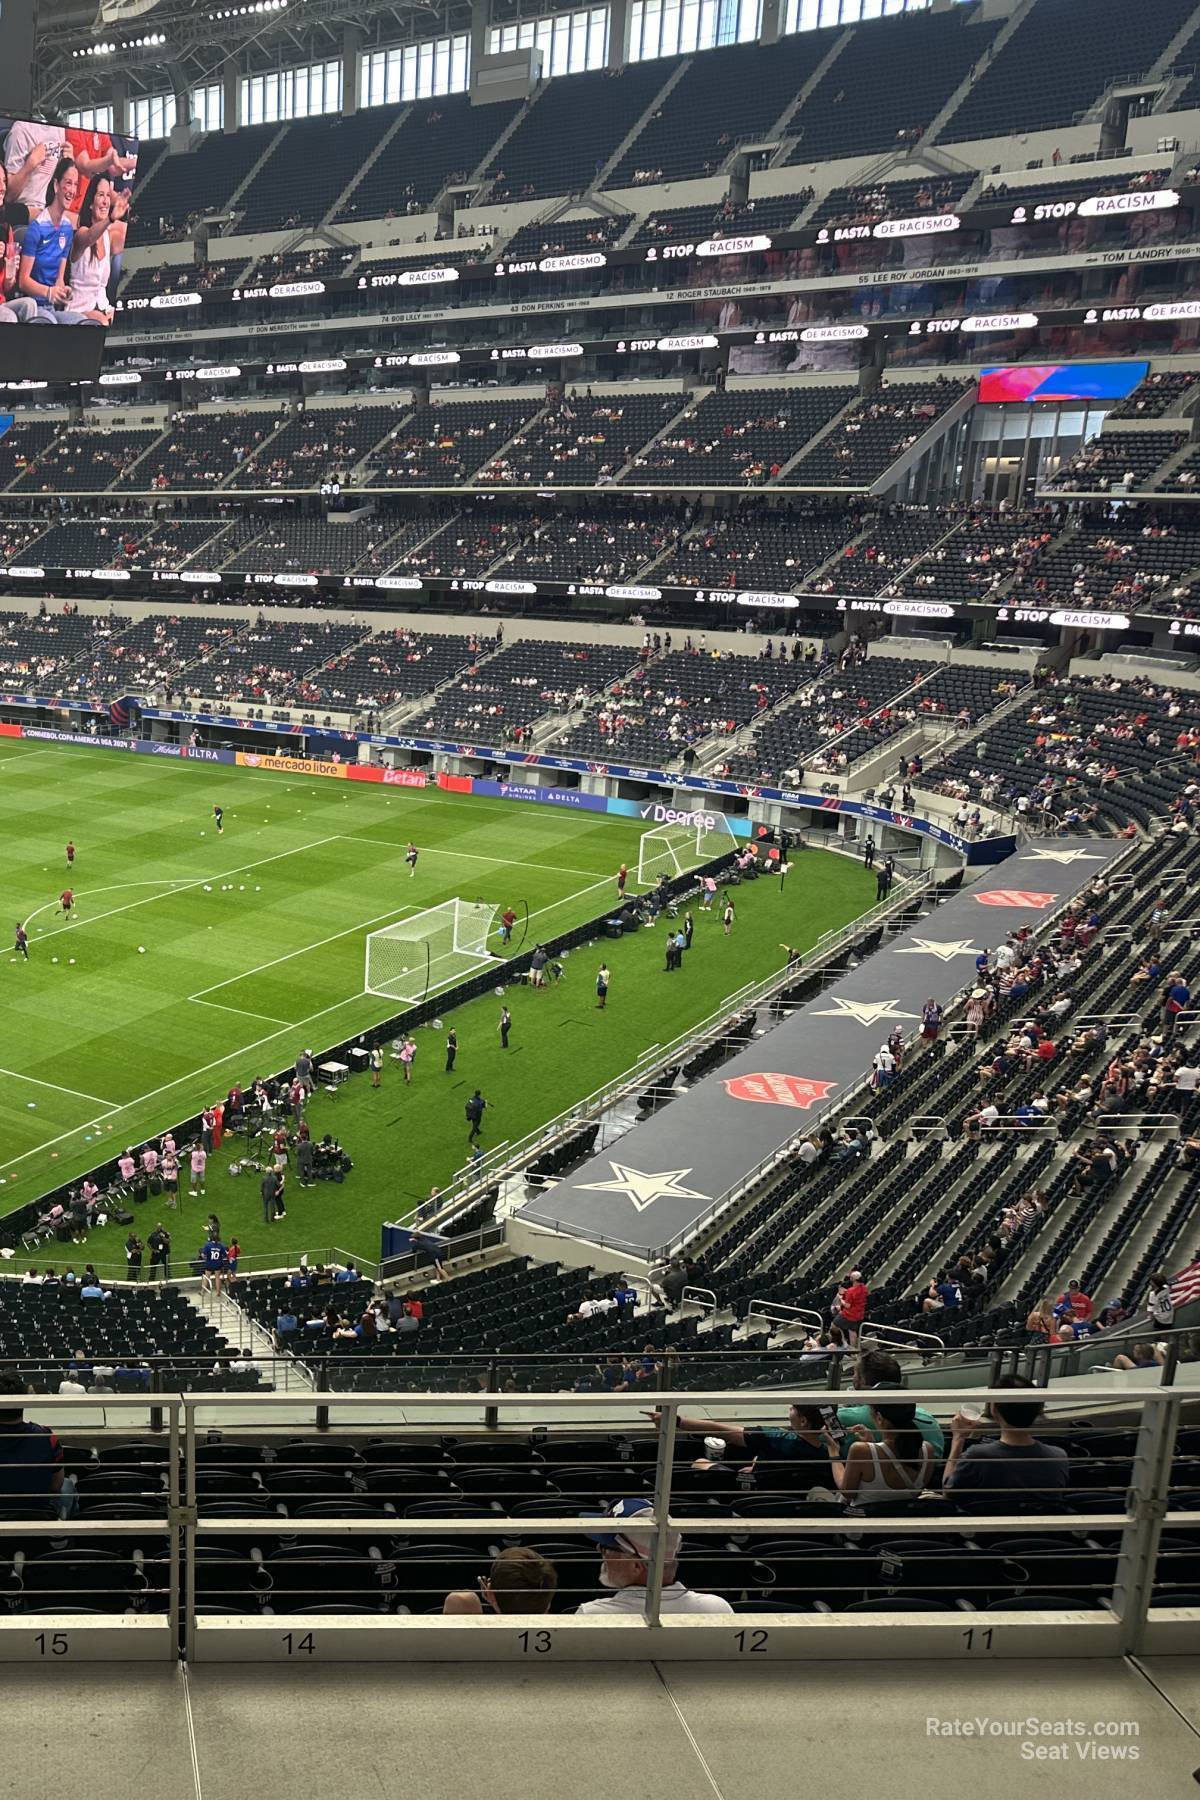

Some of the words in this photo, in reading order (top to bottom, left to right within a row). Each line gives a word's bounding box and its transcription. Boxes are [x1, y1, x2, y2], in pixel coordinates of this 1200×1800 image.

[1033, 202, 1075, 220] STOP
[1096, 195, 1155, 212] RACISM
[835, 225, 870, 240] BASTA
[881, 224, 895, 233] DE
[899, 217, 952, 232] RACISMO
[663, 244, 693, 258] STOP
[709, 239, 754, 252] RACISM
[1102, 252, 1125, 262] TOM
[1128, 248, 1172, 260] LANDRY
[509, 262, 537, 273] BASTA
[545, 259, 557, 269] DE
[559, 255, 601, 267] RACISMO
[371, 275, 397, 286] STOP
[409, 271, 445, 282] RACISM
[873, 274, 888, 283] LEE
[890, 272, 907, 281] ROY
[909, 269, 945, 280] JORDAN
[244, 288, 268, 298] BASTA
[286, 284, 321, 293] RACISMO
[677, 291, 702, 299] ROGER
[703, 287, 741, 297] STAUBACH
[127, 299, 149, 309] STOP
[159, 296, 190, 305] RACISM
[537, 302, 565, 311] PERKINS
[406, 313, 421, 321] LILLY
[1103, 308, 1140, 320] BASTA
[1151, 308, 1166, 316] DE
[269, 324, 297, 332] MEREDITH
[927, 320, 959, 332] STOP
[975, 317, 1020, 328] RACISM
[769, 331, 798, 342] BASTA
[806, 330, 818, 339] DE
[821, 327, 862, 338] RACISMO
[631, 340, 655, 350] STOP
[668, 338, 704, 348] RACISM
[502, 349, 526, 358] BASTA
[533, 348, 543, 356] DE
[545, 346, 579, 355] RACISMO
[386, 356, 407, 365] STOP
[417, 354, 449, 363] RACISM
[176, 370, 195, 379] STOP
[204, 368, 231, 377] RACISM
[276, 364, 297, 373] BASTA
[302, 362, 312, 370] DE
[313, 361, 343, 369] RACISMO
[463, 581, 484, 590] STOP
[579, 586, 603, 595] BASTA
[624, 589, 657, 597] RACISMO
[709, 592, 735, 601] STOP
[749, 595, 784, 604] RACISM
[851, 601, 880, 611] BASTA
[889, 604, 901, 612] DE
[904, 605, 947, 615] RACISMO
[1015, 610, 1048, 621] STOP
[1064, 614, 1111, 625] RACISM
[27, 730, 57, 740] CONMEBOL
[58, 733, 73, 741] COPA
[188, 750, 218, 760] ULTRA
[265, 758, 312, 772] mercado
[314, 762, 337, 775] libre
[509, 786, 536, 795] LATAM
[556, 794, 580, 803] DELTA
[654, 806, 715, 829] Degree
[211, 1251, 219, 1260] 10
[34, 1632, 69, 1656] 15
[282, 1632, 316, 1655] 14
[517, 1630, 553, 1654] 13
[734, 1629, 768, 1653] 12
[962, 1627, 994, 1650] 11
